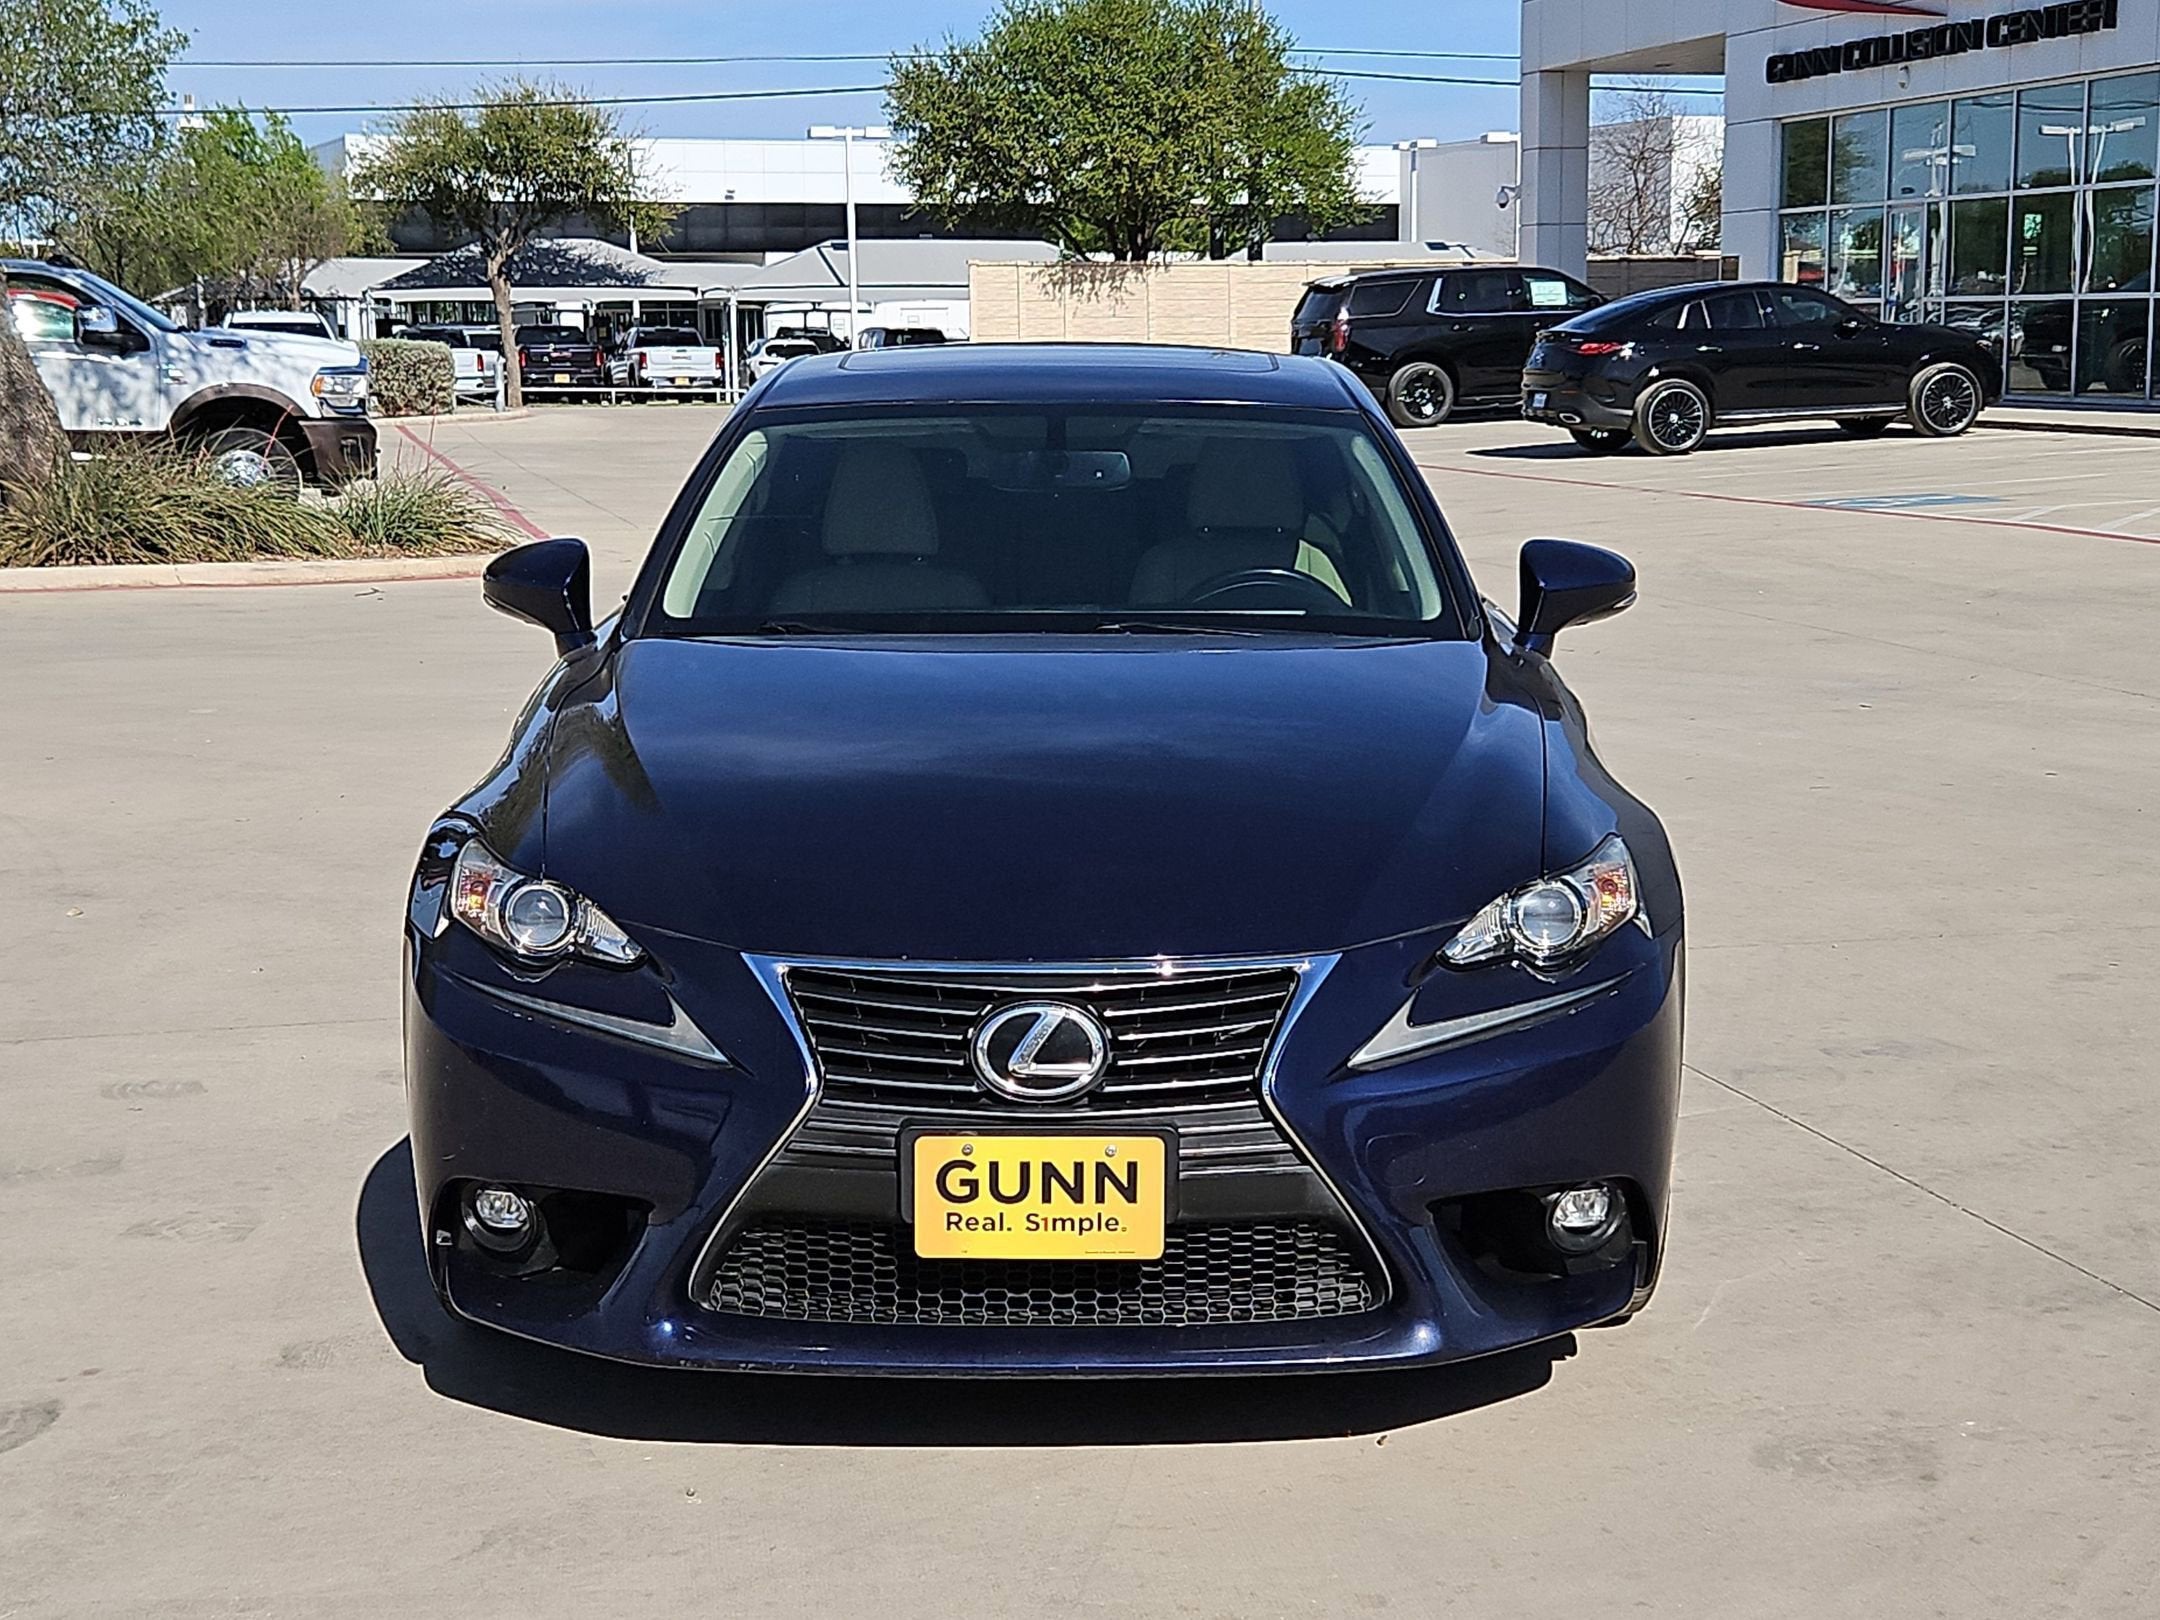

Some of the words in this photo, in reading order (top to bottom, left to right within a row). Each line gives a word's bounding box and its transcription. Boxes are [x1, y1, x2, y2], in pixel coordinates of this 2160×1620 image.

[1766, 46, 1842, 84] GUNN
[1843, 19, 1984, 71] COLLISION
[1986, 0, 2118, 48] CENTER
[935, 1159, 1138, 1205] GUNN
[945, 1212, 1013, 1233] Real.
